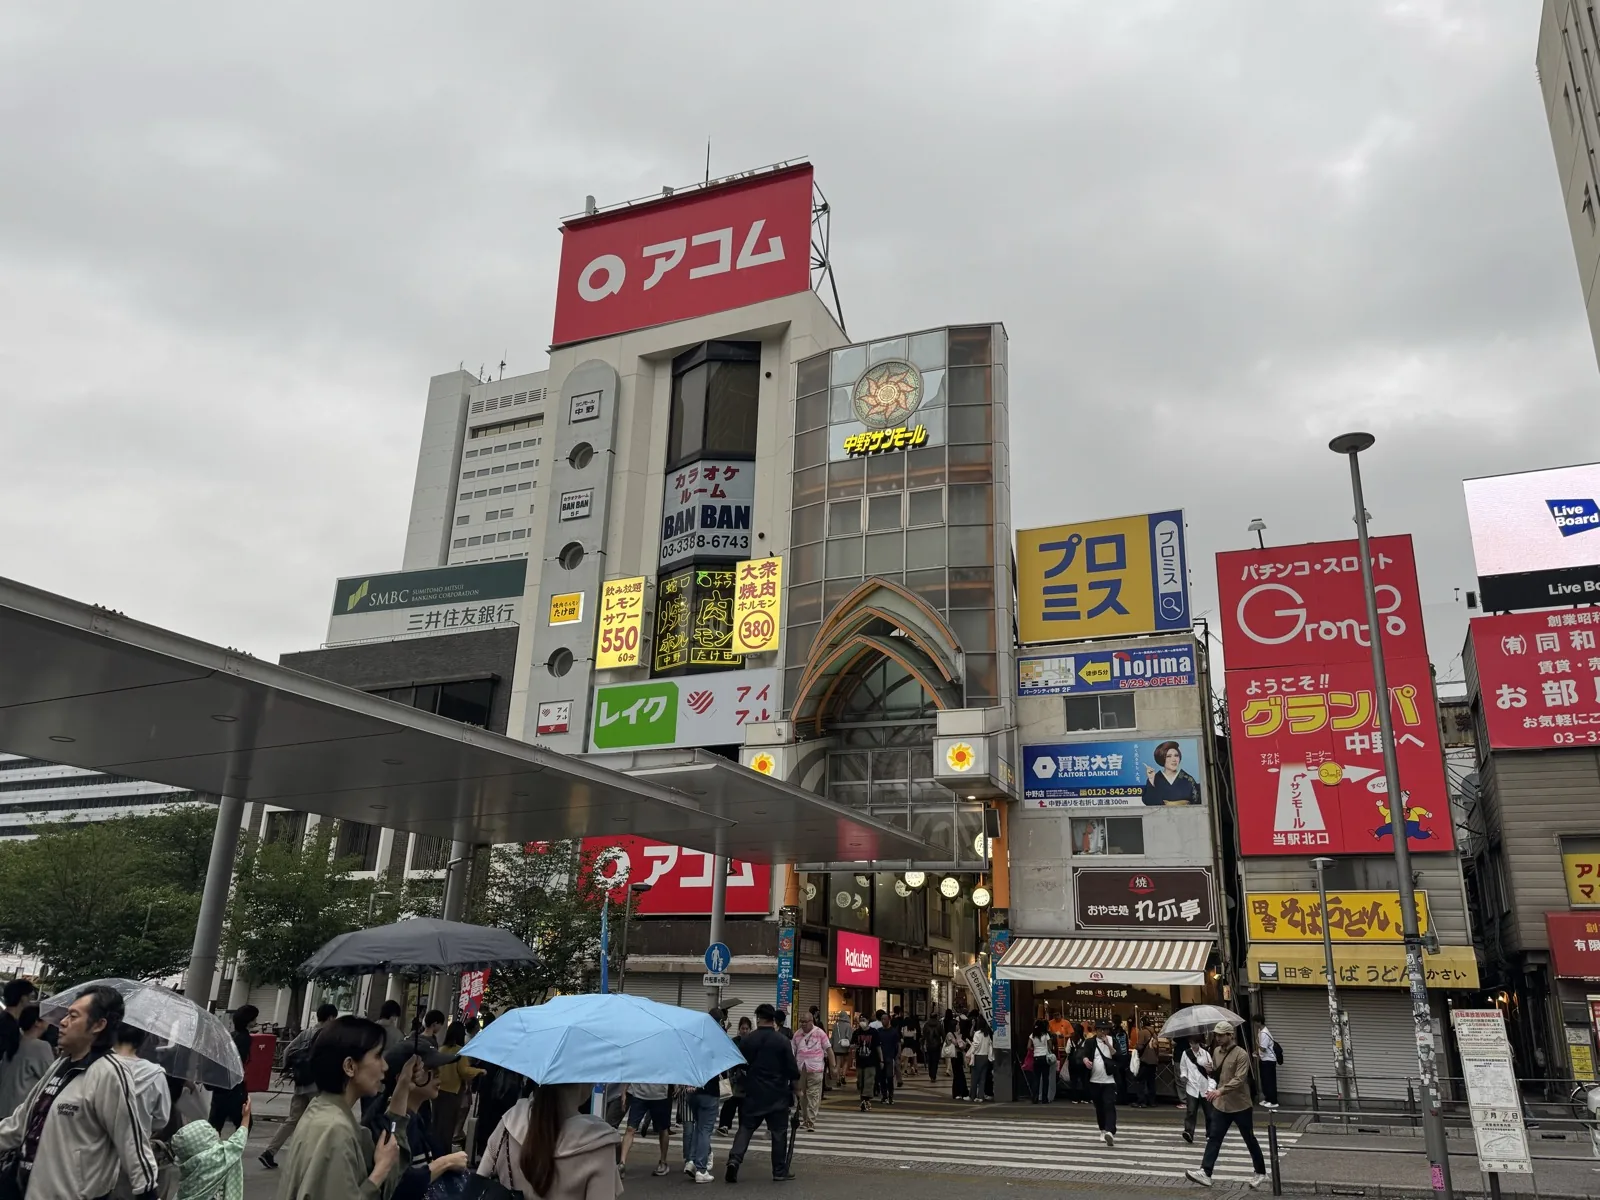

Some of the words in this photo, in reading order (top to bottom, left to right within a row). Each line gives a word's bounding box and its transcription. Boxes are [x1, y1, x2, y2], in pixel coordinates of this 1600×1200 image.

[643, 219, 786, 291] アコム
[574, 405, 595, 415] 中野
[844, 424, 927, 455] 中野サンモール
[676, 465, 740, 489] カラオケ
[680, 484, 726, 504] ルーム
[562, 501, 575, 511] BAN
[576, 500, 589, 509] BAN
[1553, 506, 1583, 516] Live
[663, 506, 697, 540] BAN
[700, 504, 750, 530] BAN
[1555, 513, 1600, 527] Board
[662, 535, 749, 559] 03-3388-6743
[1039, 533, 1126, 579] プロ
[1160, 530, 1178, 585] プロミス
[1241, 553, 1393, 580] パチンコ・スロト
[740, 561, 778, 580] 大衆
[369, 589, 410, 606] SMBC
[412, 587, 444, 595] SUMITOMO
[411, 594, 437, 602] BANKING
[438, 590, 480, 599] CORPORATION
[605, 582, 642, 596] 飲み放題
[738, 579, 776, 600] 焼肉
[1548, 584, 1582, 595] Live
[605, 597, 640, 611] レモン
[738, 600, 776, 611] ホルモン
[1042, 579, 1130, 621] ミス
[407, 604, 515, 631] 三井住友銀行
[553, 608, 576, 617] たけ田
[603, 612, 639, 625] サワー
[601, 626, 639, 653] 550
[617, 653, 636, 662] 60分
[1112, 652, 1191, 677] nojima
[1120, 678, 1144, 688] 5/29
[1150, 675, 1189, 687] OPEN!!
[1246, 674, 1329, 695] ようこそ!!
[736, 684, 771, 703] アイ
[599, 696, 668, 727] レイク
[1057, 754, 1123, 771] 買取大吉
[1058, 770, 1086, 778] KAITORI
[1025, 790, 1045, 798] 中野店
[1087, 788, 1143, 796] 0120-842-999
[1291, 783, 1305, 829] サンモール
[1273, 833, 1329, 845] 当駅北口
[845, 948, 873, 969] Rakuten
[1426, 968, 1467, 980] かさい
